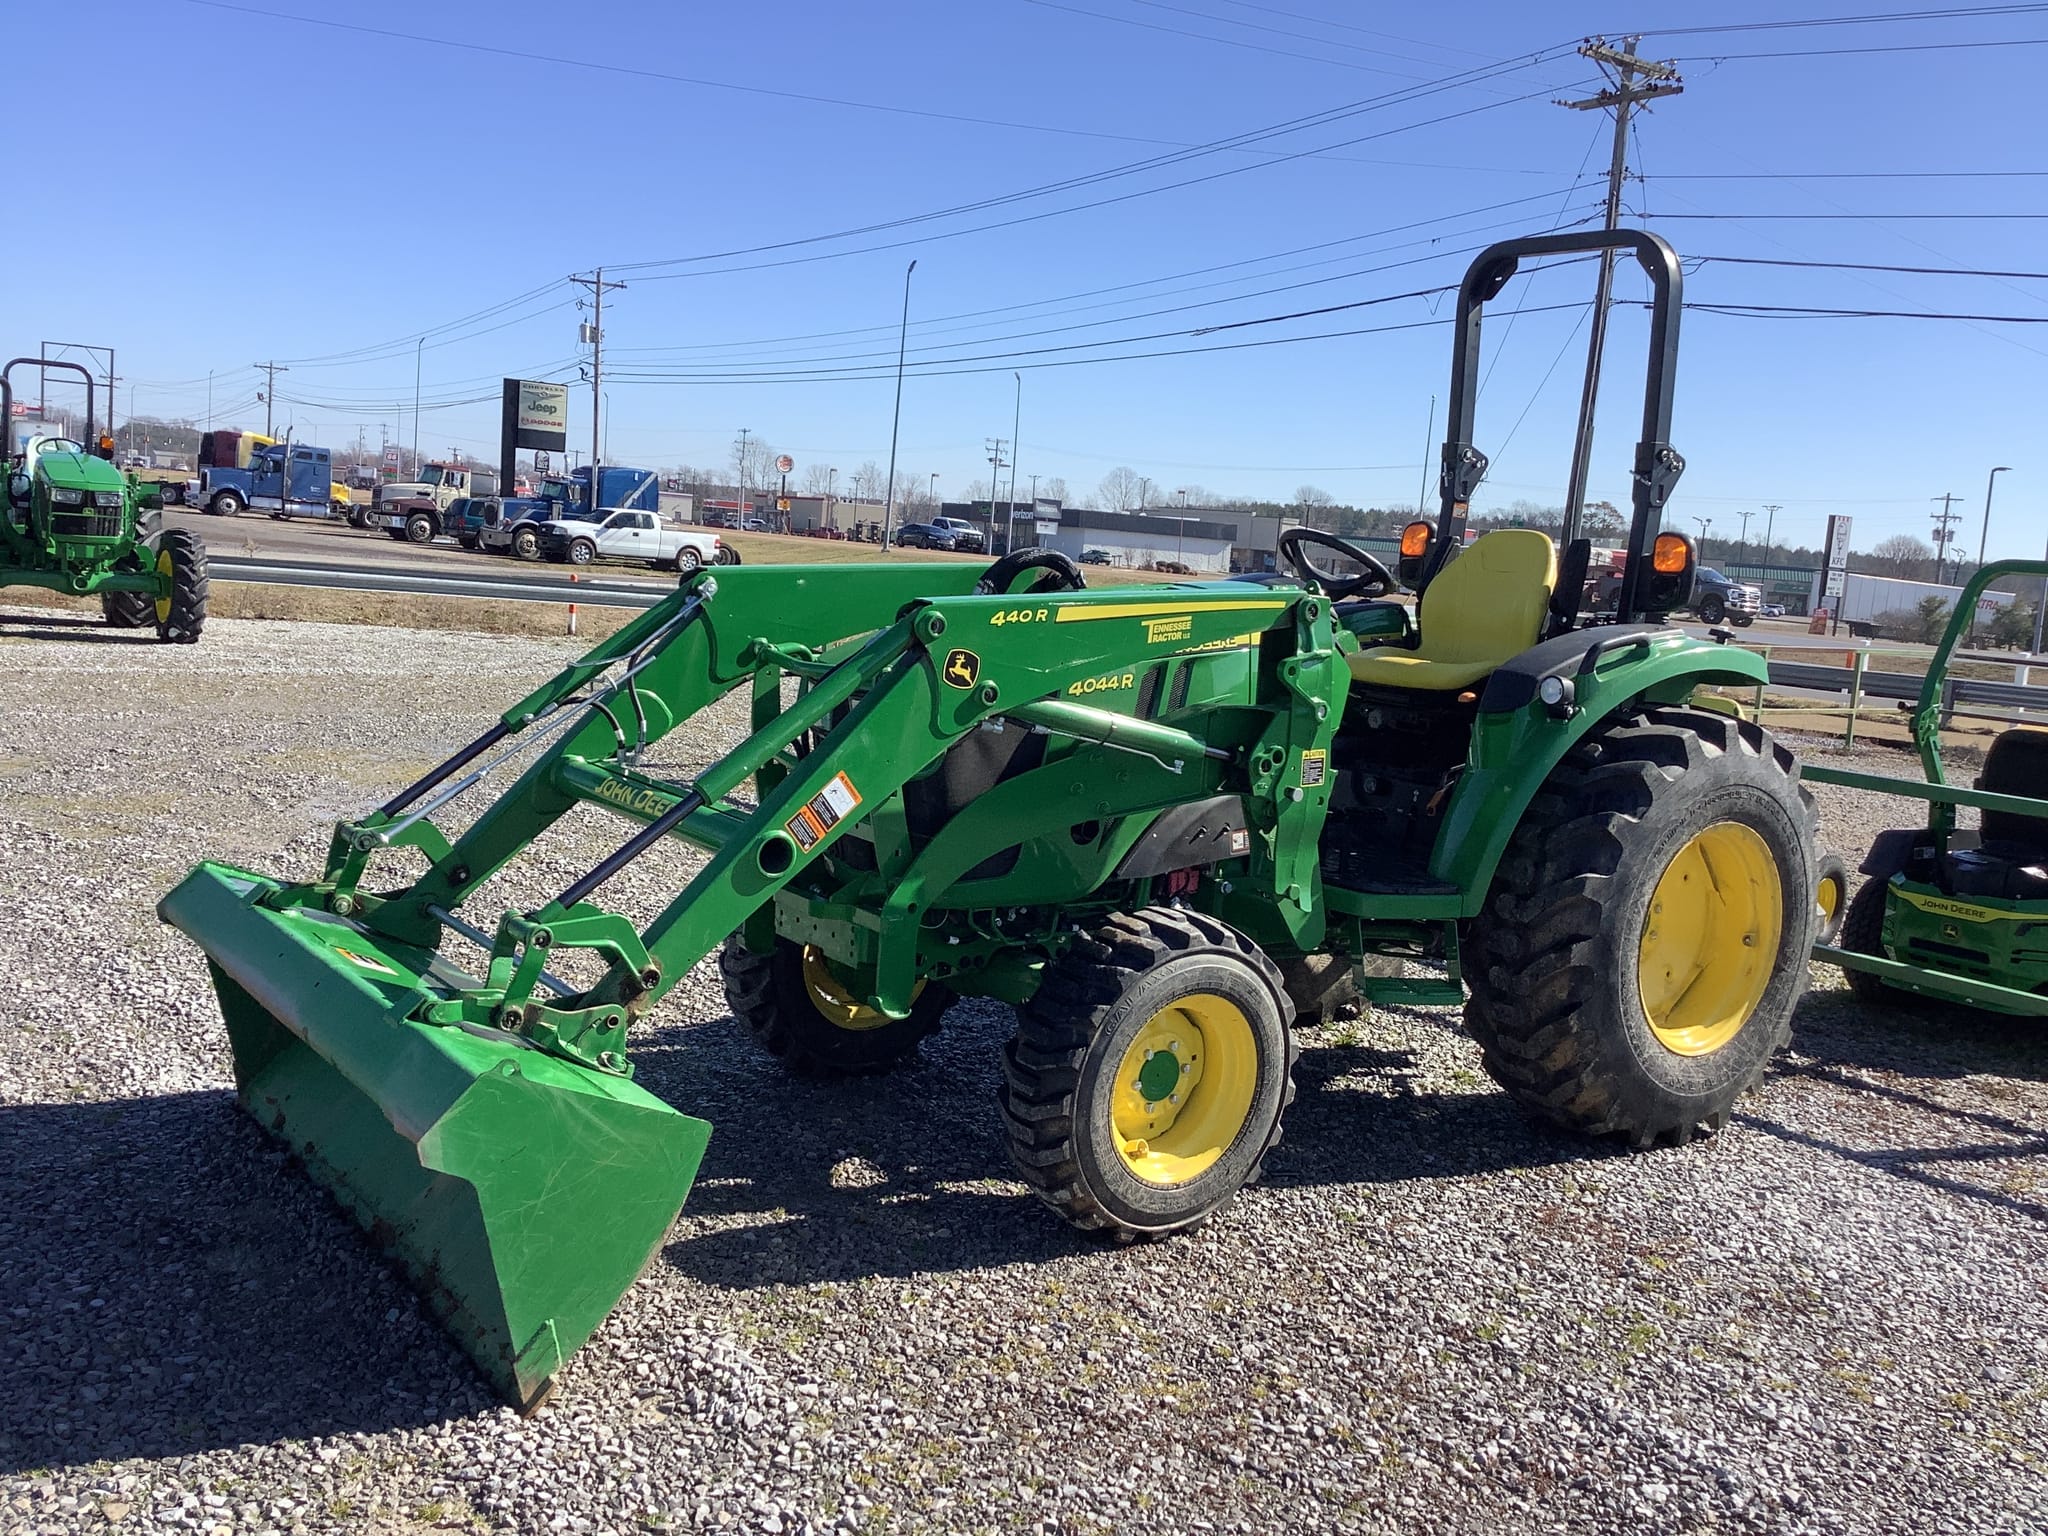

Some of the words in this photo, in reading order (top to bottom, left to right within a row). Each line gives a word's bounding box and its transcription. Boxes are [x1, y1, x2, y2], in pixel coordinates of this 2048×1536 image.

[528, 400, 557, 415] Jeep
[530, 419, 563, 427] DODGE
[1831, 556, 1845, 566] KFC
[1141, 616, 1192, 634] TENNESSEE
[595, 776, 639, 805] JOHN
[1921, 899, 1949, 911] JOHN
[1950, 904, 1986, 919] DEERE
